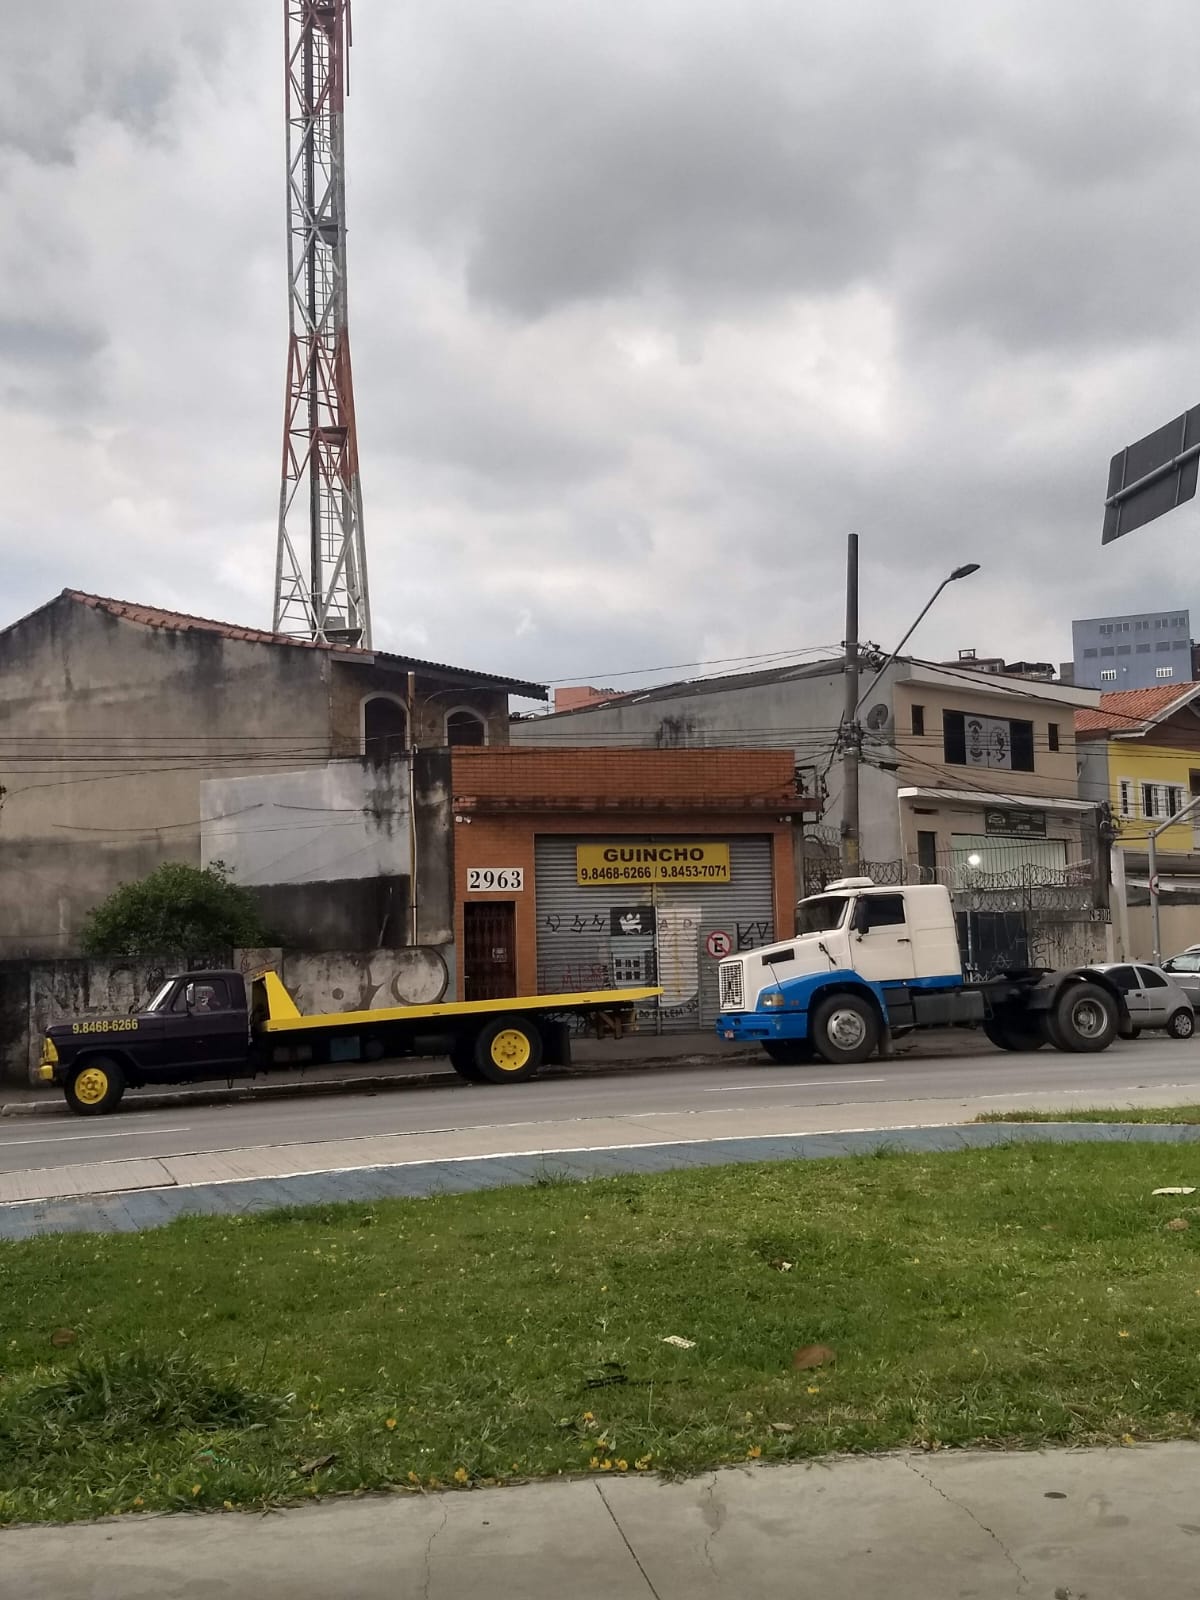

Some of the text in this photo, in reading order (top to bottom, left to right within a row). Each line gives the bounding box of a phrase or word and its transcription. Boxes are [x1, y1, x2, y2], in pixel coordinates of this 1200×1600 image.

[603, 848, 704, 862] GUINCHO
[470, 870, 521, 889] 2963
[581, 866, 651, 880] 9.8468-6266
[660, 865, 727, 878] 9.8453-7071
[714, 937, 724, 952] E
[72, 1018, 138, 1034] 9.8468-6266
